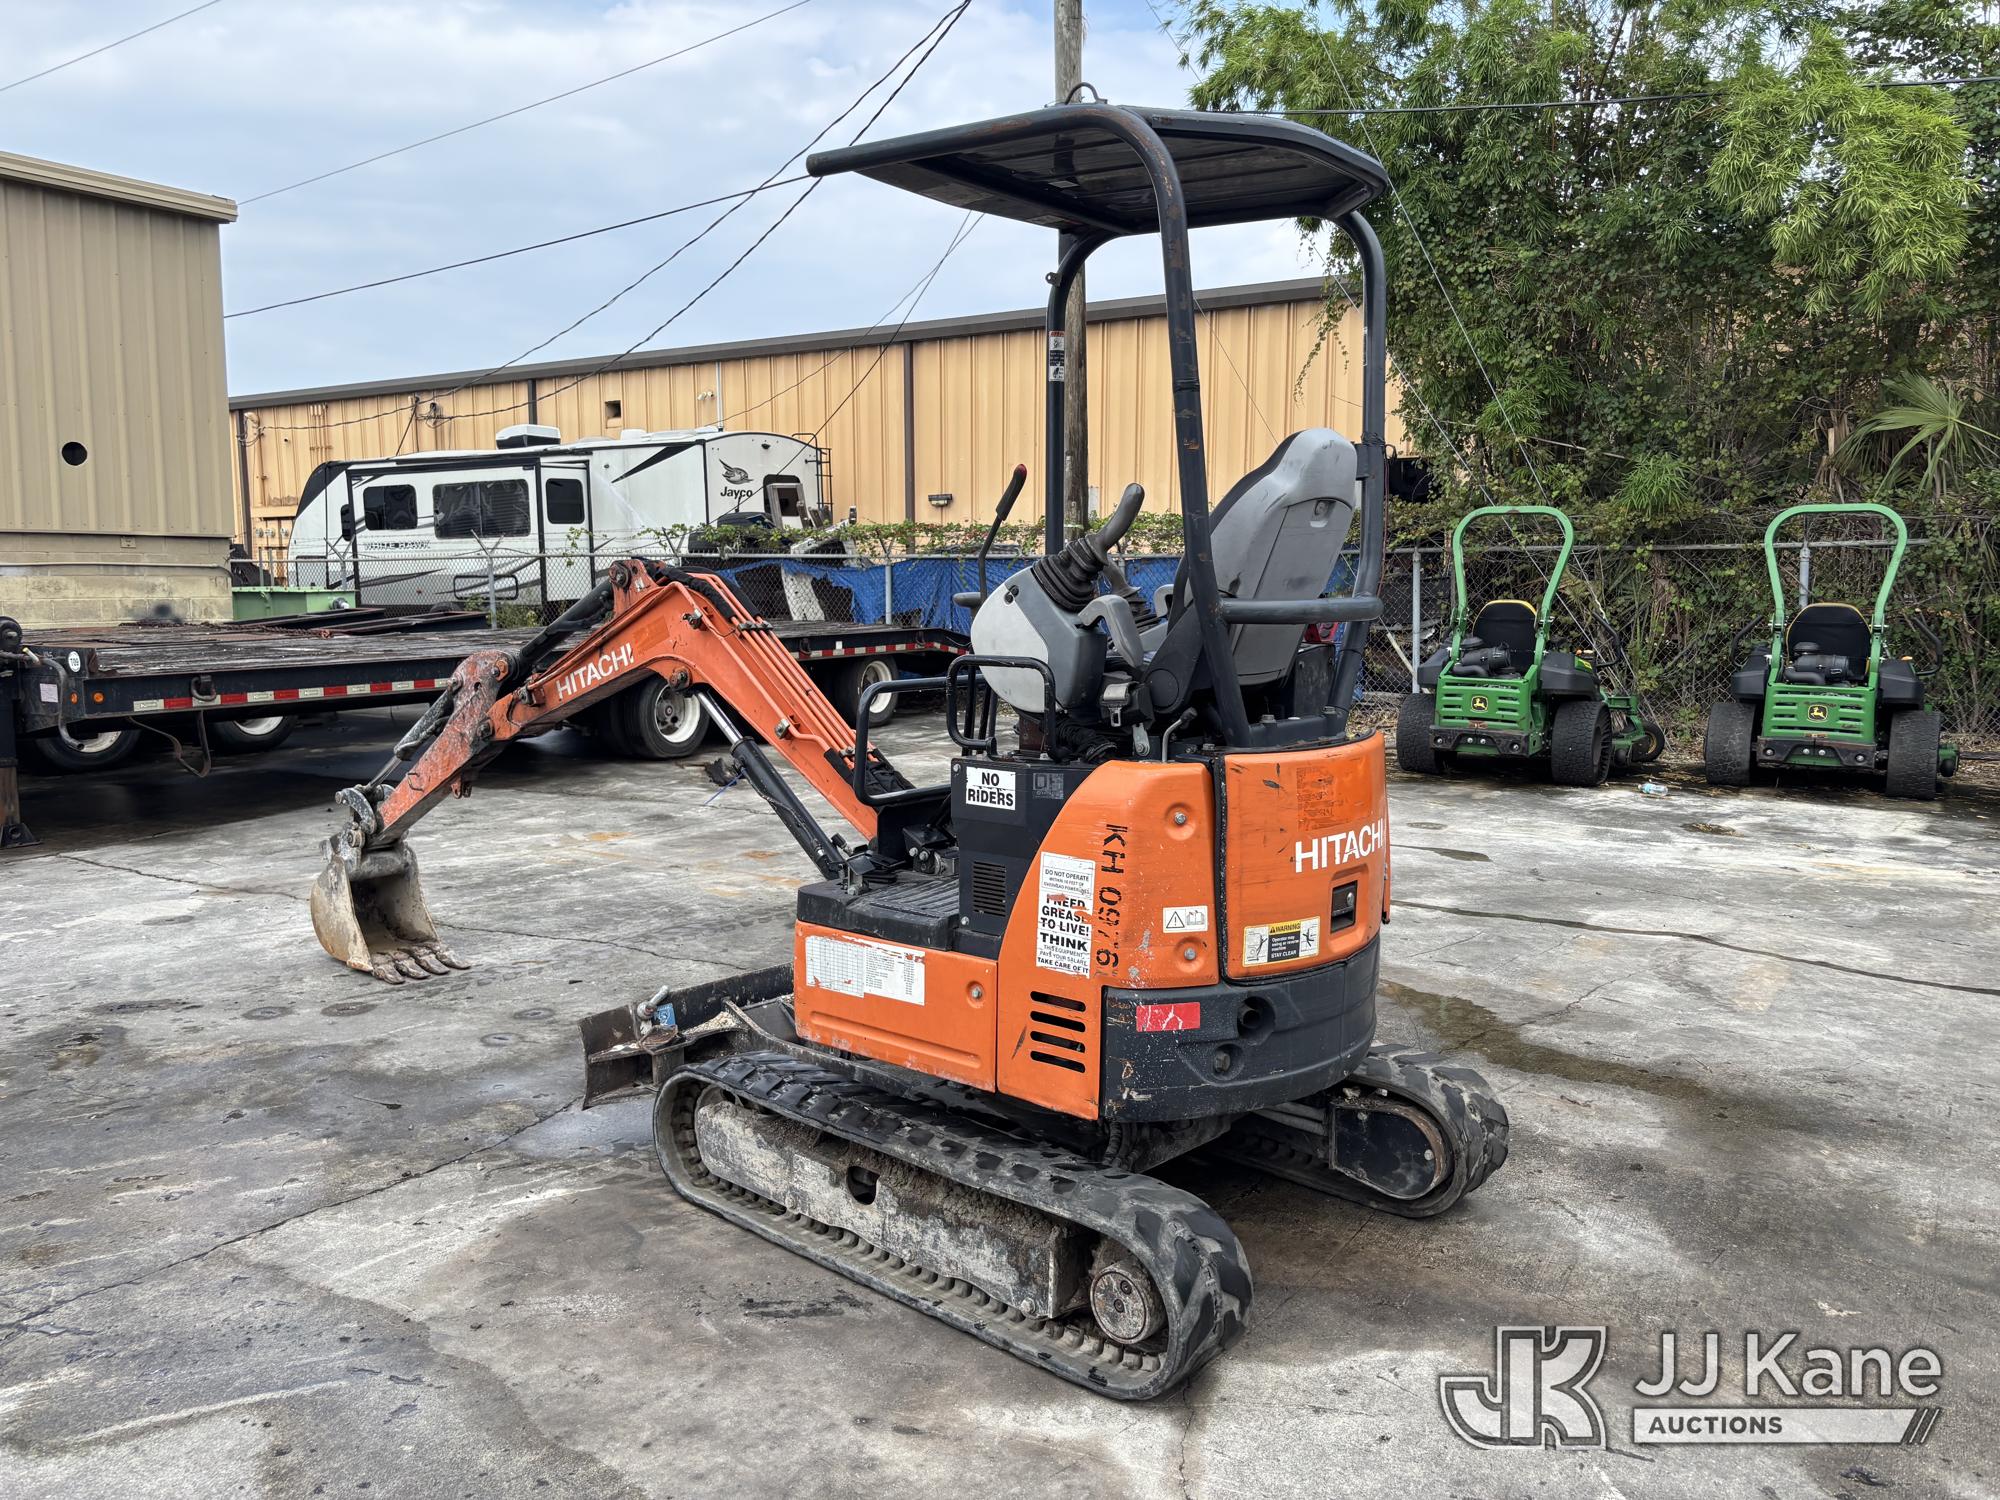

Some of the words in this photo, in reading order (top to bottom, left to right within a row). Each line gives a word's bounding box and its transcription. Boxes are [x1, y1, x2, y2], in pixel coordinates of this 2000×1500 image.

[720, 486, 753, 499] Jayco
[556, 642, 634, 700] HITACHI
[981, 772, 1000, 786] NO
[967, 788, 1014, 806] RIDERS
[1101, 824, 1128, 873] KH
[1295, 818, 1383, 873] HITACHI
[1066, 873, 1089, 881] OPERATE
[1040, 917, 1056, 929] TO
[1060, 921, 1089, 936] LIVE!
[1276, 923, 1300, 931] WARNING
[1040, 932, 1088, 952] THINK
[1038, 957, 1053, 965] TAKE
[1054, 961, 1071, 969] CARE
